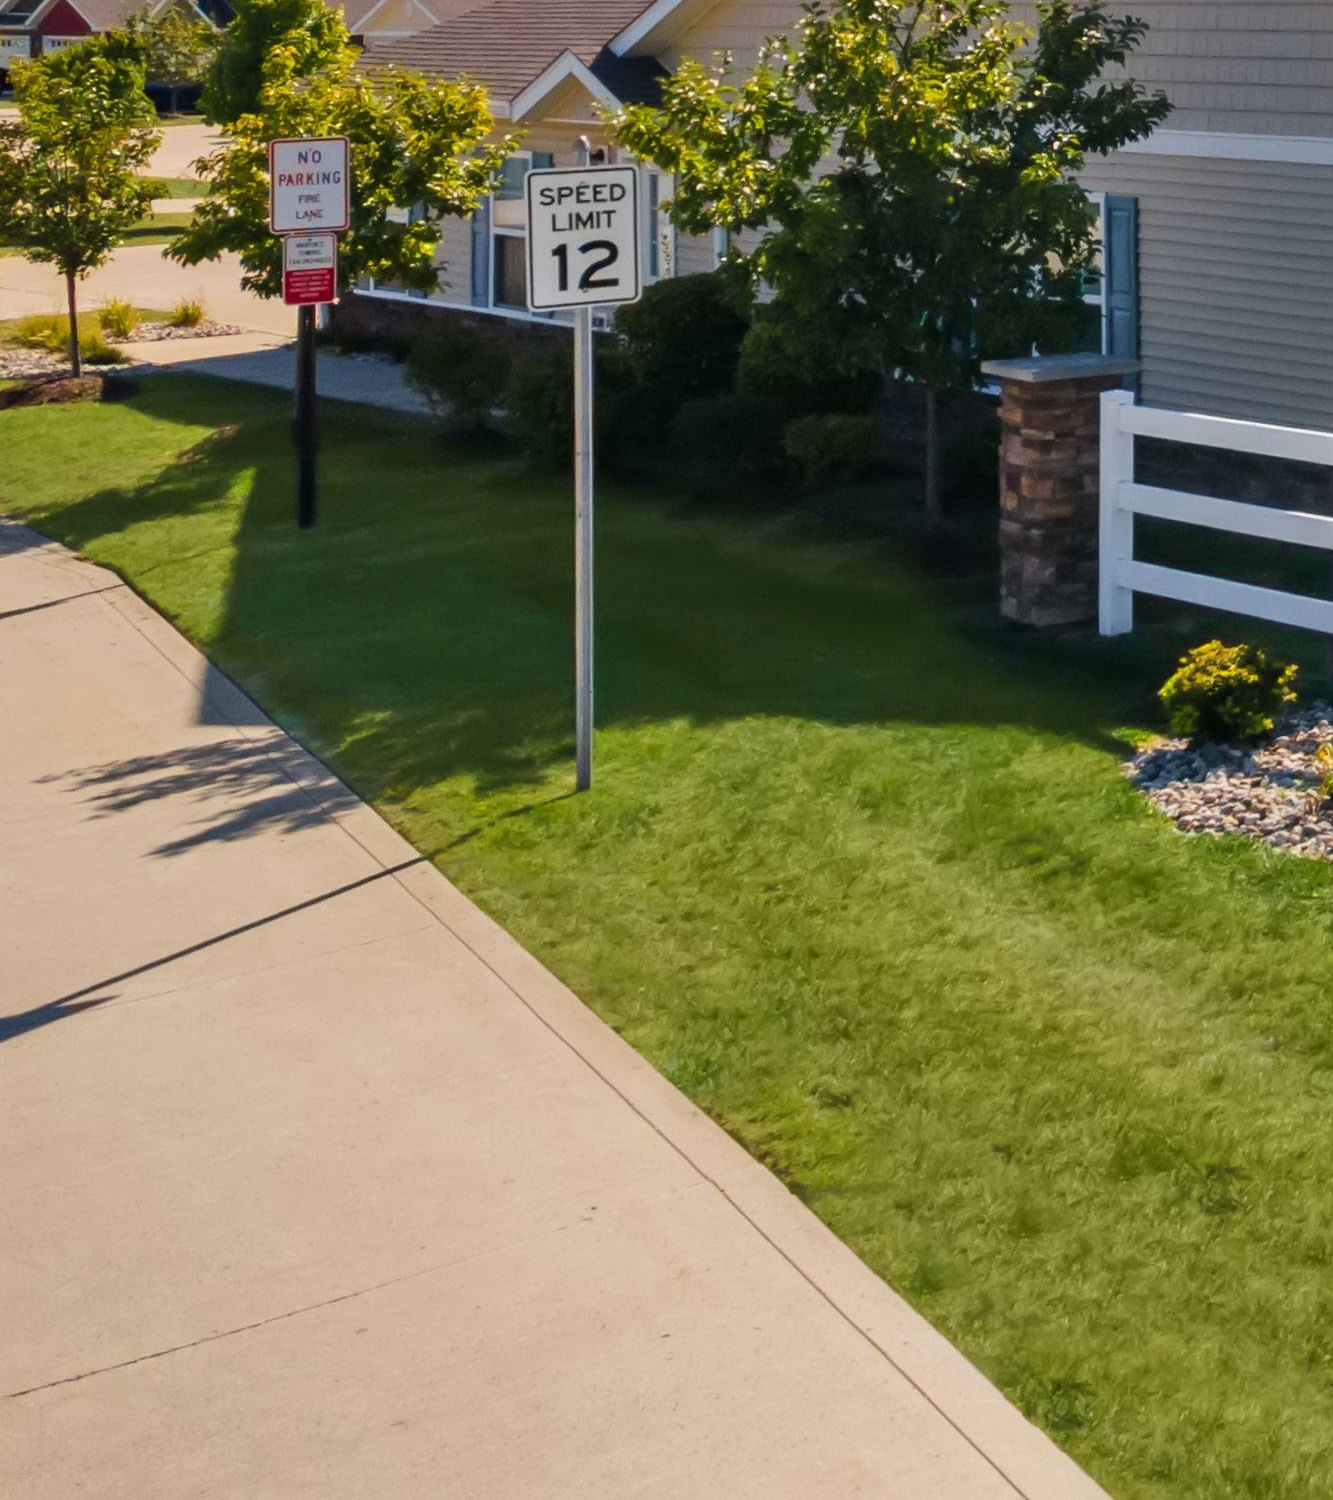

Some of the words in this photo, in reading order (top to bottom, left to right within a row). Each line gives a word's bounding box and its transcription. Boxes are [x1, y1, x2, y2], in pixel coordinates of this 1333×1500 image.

[298, 150, 322, 164] NO
[278, 171, 341, 187] PARKING
[298, 193, 321, 204] FIRE
[539, 183, 626, 206] SPEED
[295, 209, 323, 219] LANE
[552, 210, 617, 232] LIMIT
[551, 239, 619, 292] 12
